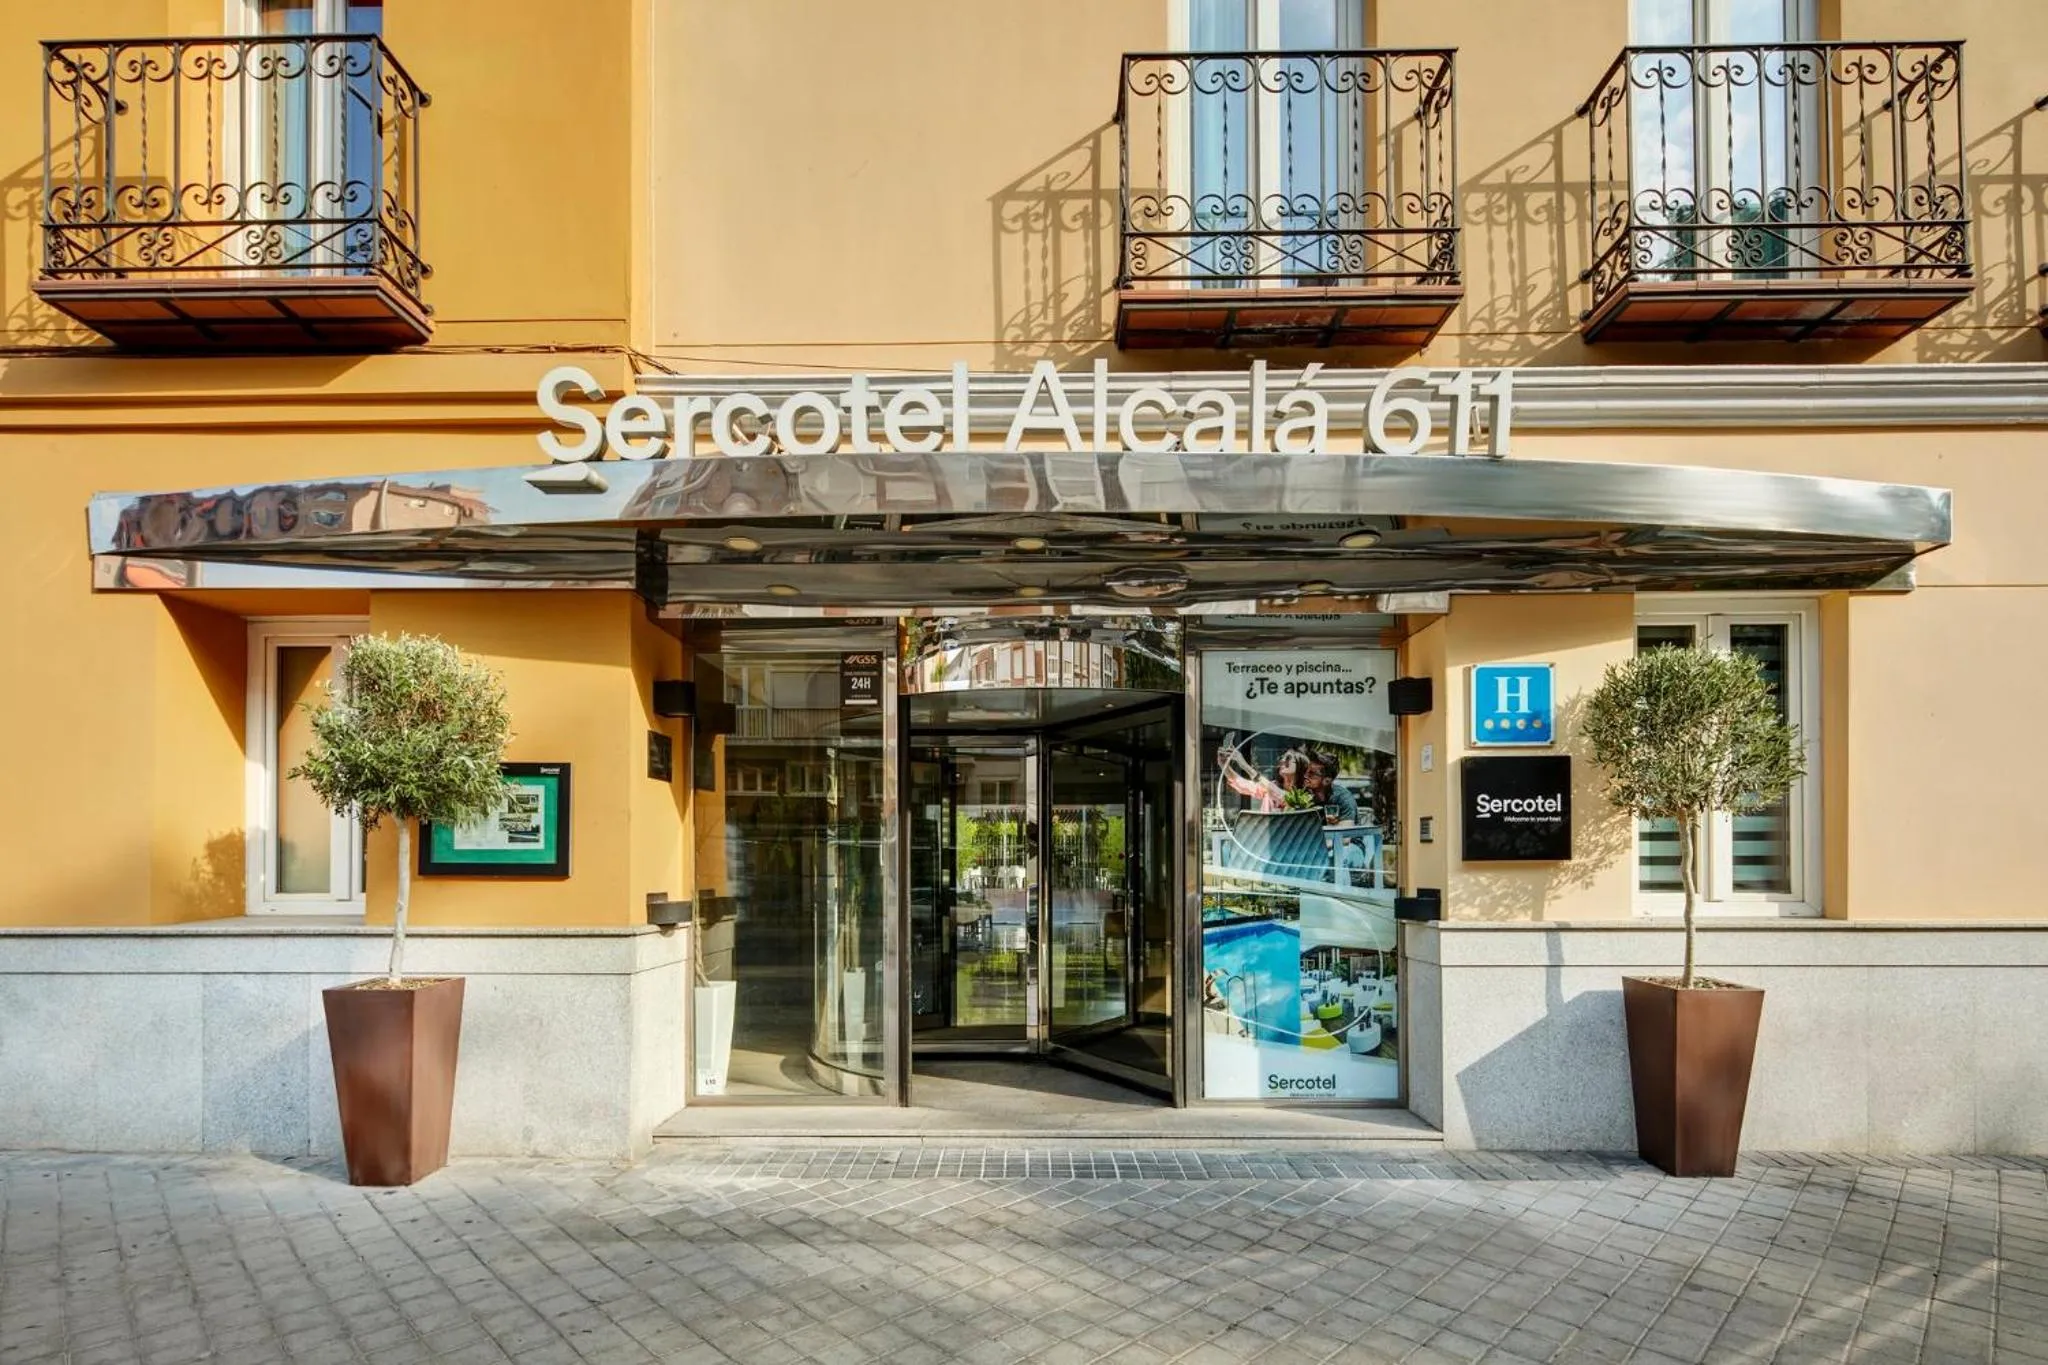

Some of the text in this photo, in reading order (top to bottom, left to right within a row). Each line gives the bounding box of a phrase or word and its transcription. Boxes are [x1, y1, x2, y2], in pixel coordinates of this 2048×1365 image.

[536, 358, 1513, 463] Sercotel Alcalá 611
[1225, 661, 1353, 676] Terraceo y piscina...
[851, 676, 872, 690] 24H
[1245, 676, 1377, 700] ¿Te apuntas?
[1493, 676, 1533, 714] H
[1476, 793, 1562, 813] Sercotel
[1267, 1073, 1336, 1090] Sercotel
